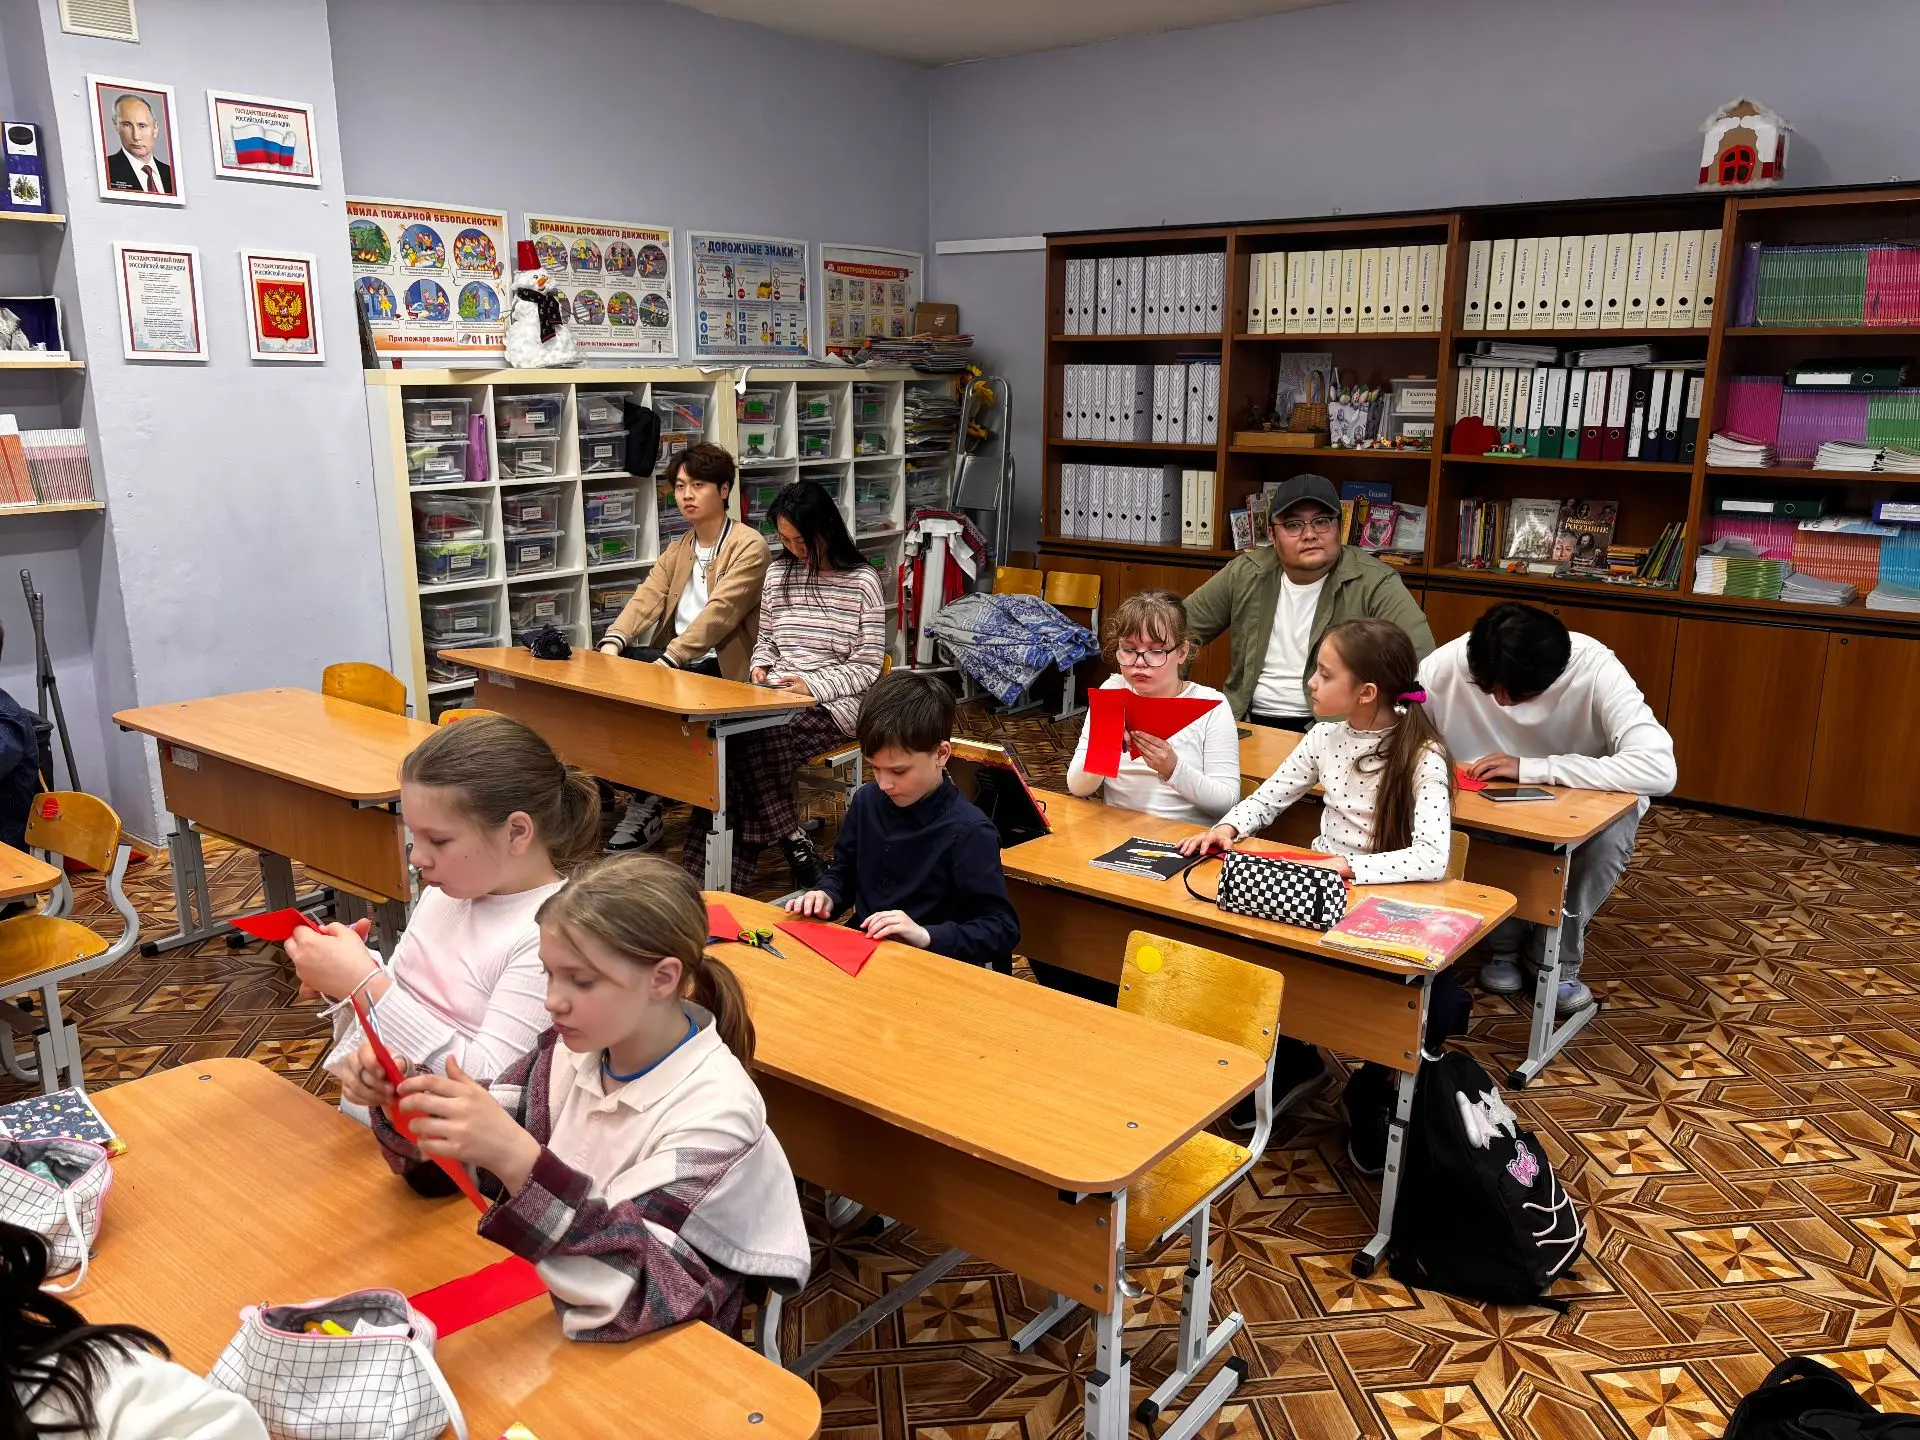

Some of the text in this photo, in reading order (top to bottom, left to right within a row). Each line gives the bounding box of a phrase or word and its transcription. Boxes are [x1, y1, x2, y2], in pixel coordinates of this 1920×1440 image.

[346, 206, 498, 228] АВИЛА ПОЖАРНОЙ БЕЗОПАСНОСТИ
[540, 222, 660, 242] ПРАВИЛА ДОРОЖНОГО ДВИЖЕНИЯ
[708, 240, 794, 259] ДОРОЖНЫЕ ЗНАКИ
[388, 335, 504, 345] При пожаре звони: 01 112
[1461, 378, 1470, 416] Математика
[1472, 376, 1482, 415] Окруж. Мир
[1520, 375, 1529, 397] КИМы
[1534, 376, 1545, 415] Технология
[1500, 398, 1509, 424] Русский
[1572, 392, 1580, 408] ИЗО
